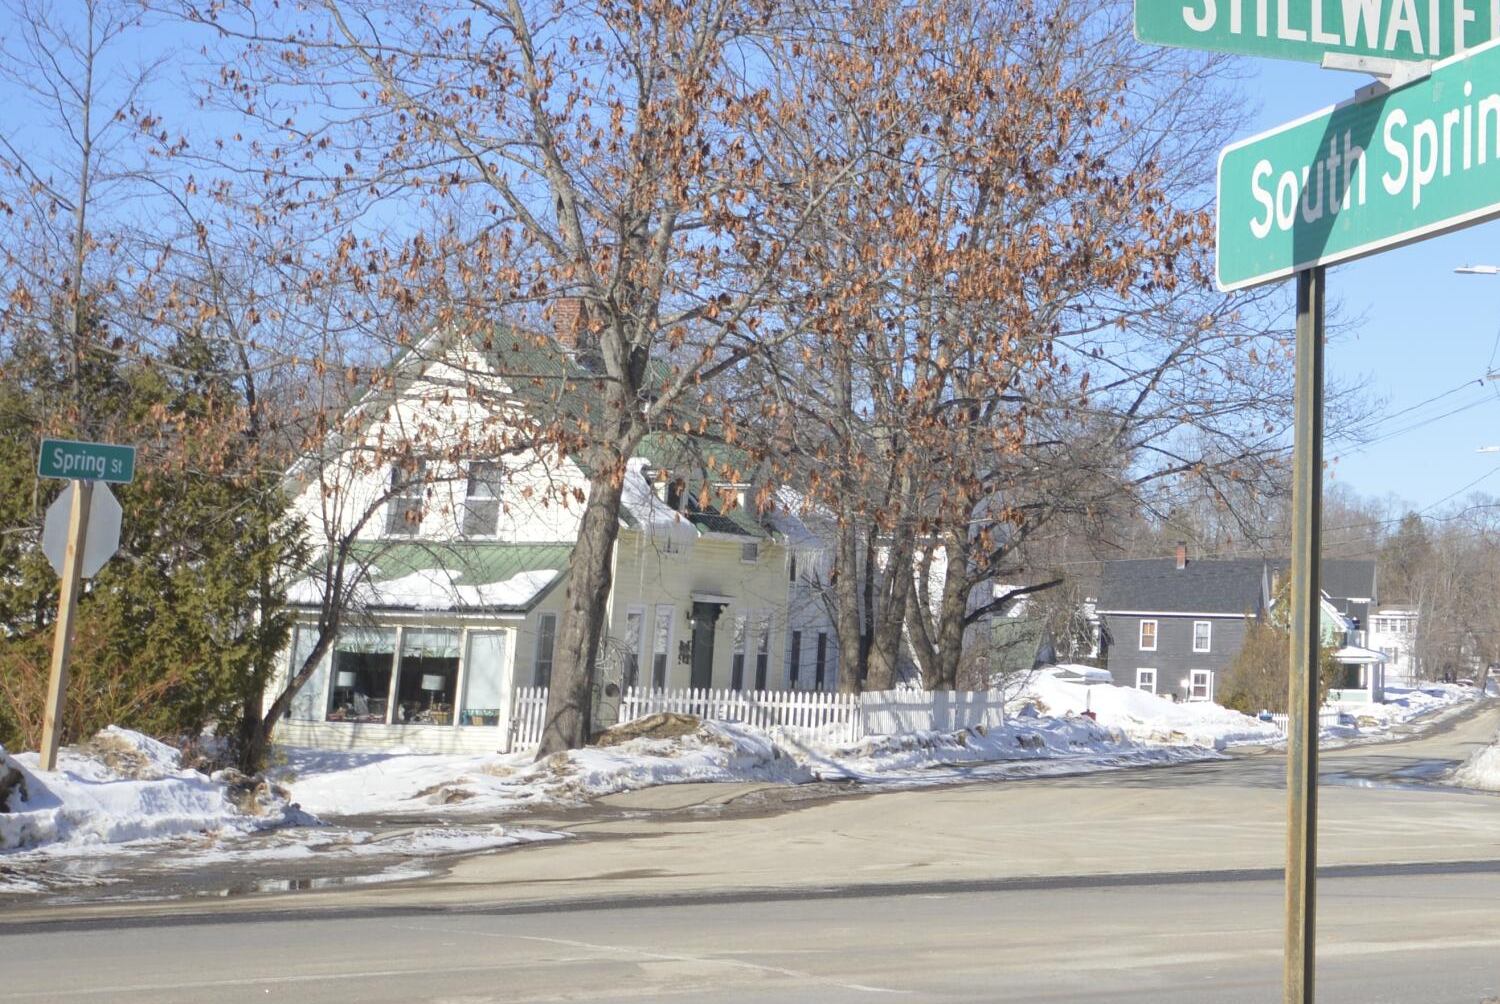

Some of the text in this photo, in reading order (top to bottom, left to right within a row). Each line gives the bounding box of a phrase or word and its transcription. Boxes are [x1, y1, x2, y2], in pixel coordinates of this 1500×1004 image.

[1250, 128, 1367, 240] South
[52, 448, 123, 477] Spring St
